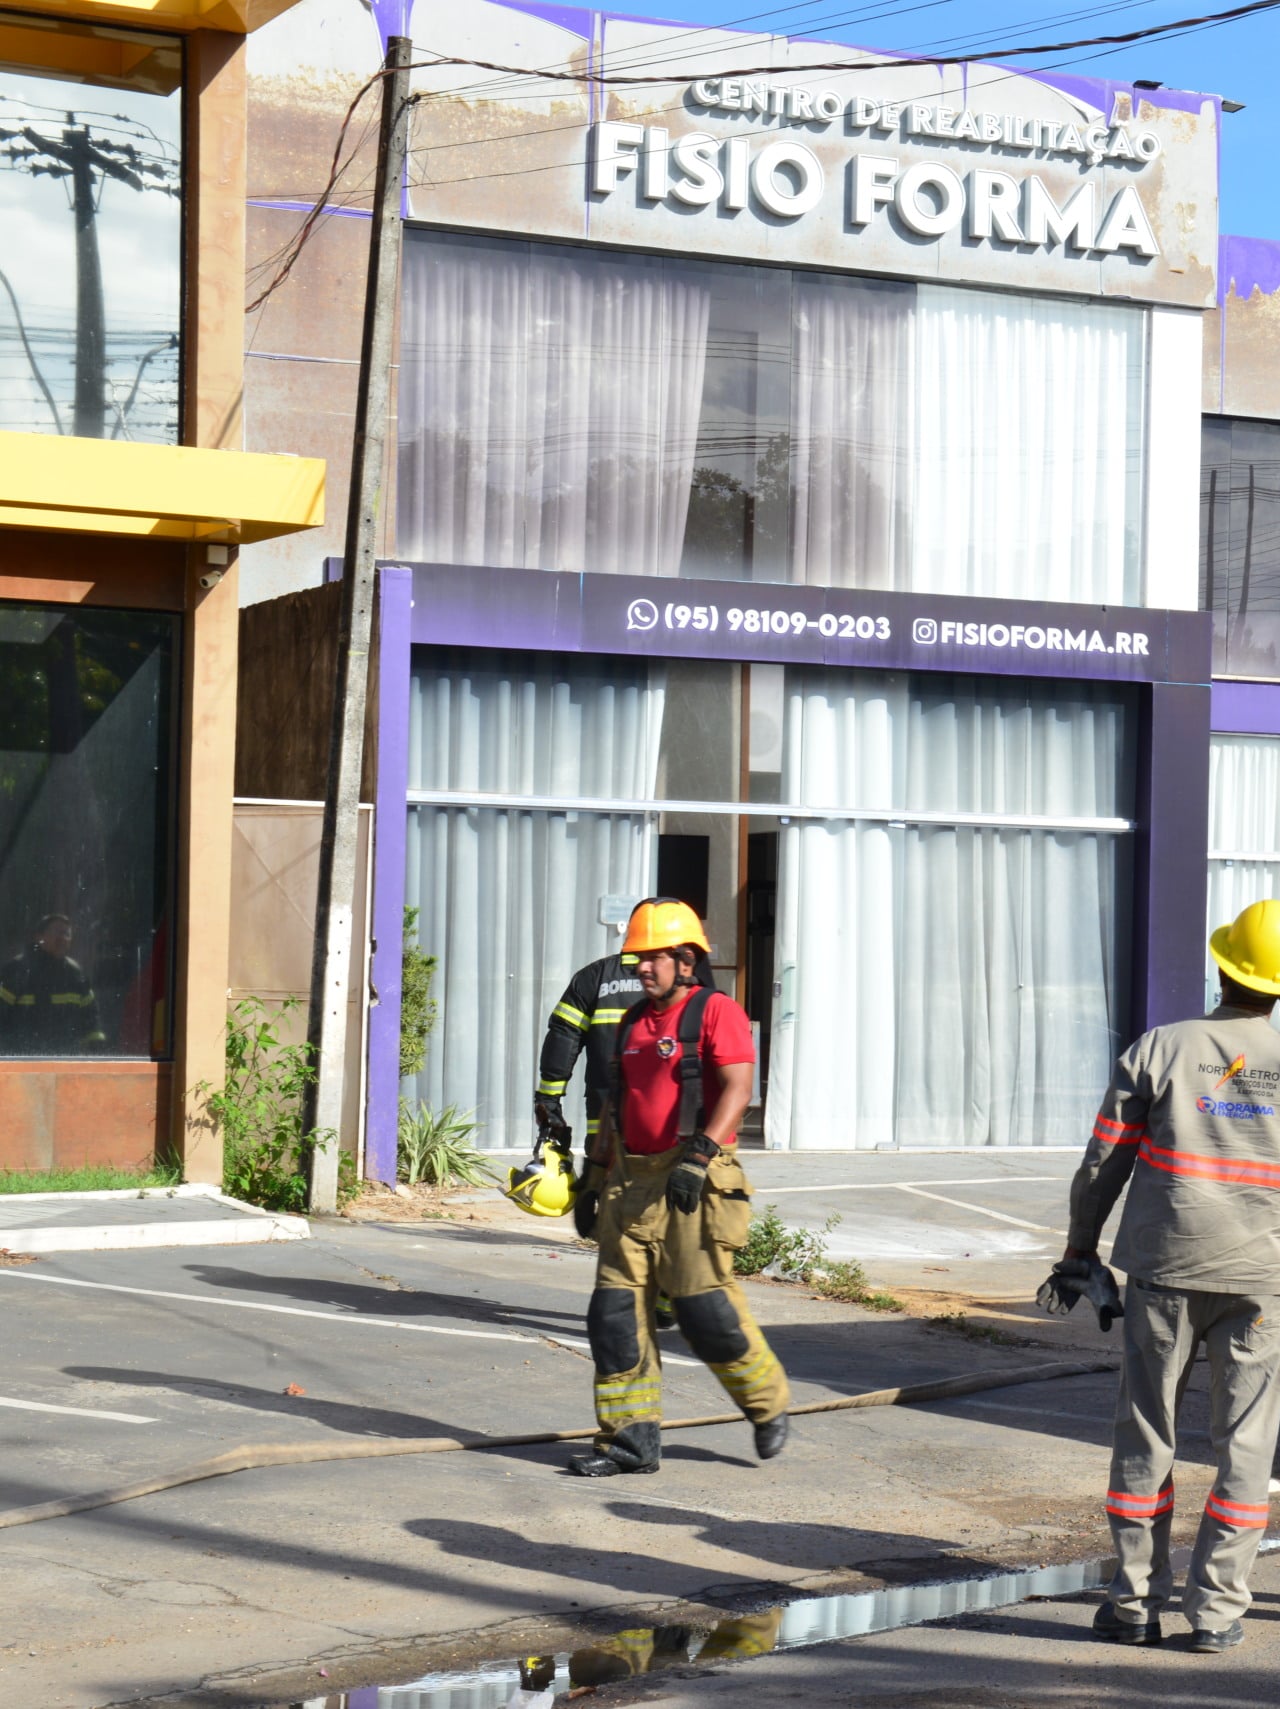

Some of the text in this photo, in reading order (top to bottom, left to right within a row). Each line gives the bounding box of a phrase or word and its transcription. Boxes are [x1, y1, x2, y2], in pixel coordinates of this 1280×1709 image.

[692, 78, 1162, 167] CENTRO DE REABILITAÇÃO
[593, 120, 1161, 257] FISIO FORMA
[664, 604, 892, 641] (95) 98109-0203
[941, 621, 1150, 656] FISIOFORMA.RR
[598, 979, 644, 998] BOMB
[1217, 1101, 1275, 1116] RORAIMA
[1217, 1110, 1254, 1120] ENERGIA
